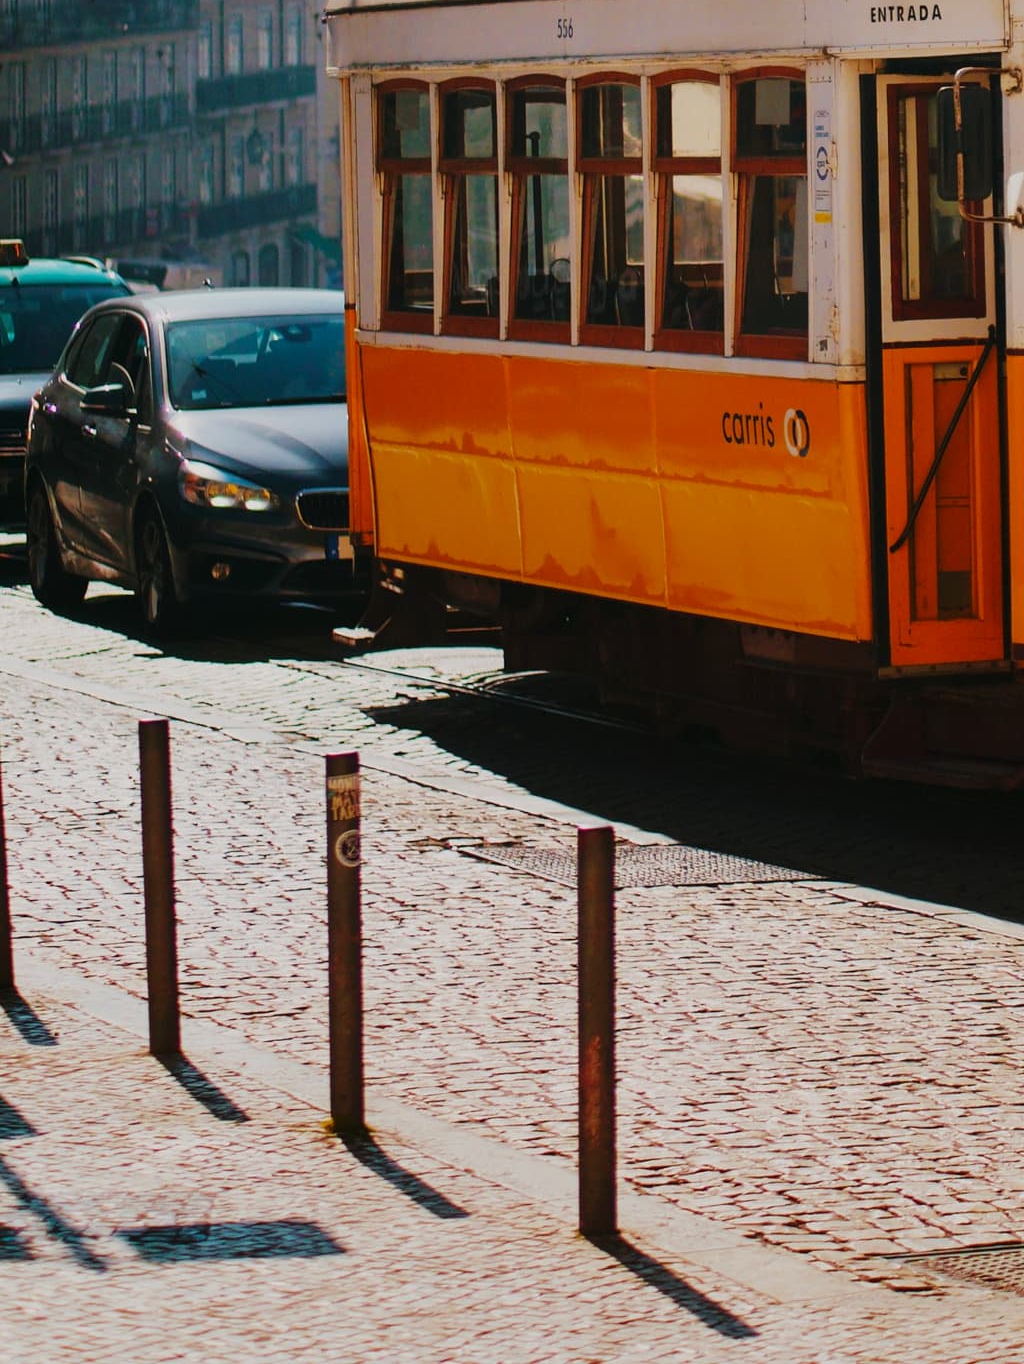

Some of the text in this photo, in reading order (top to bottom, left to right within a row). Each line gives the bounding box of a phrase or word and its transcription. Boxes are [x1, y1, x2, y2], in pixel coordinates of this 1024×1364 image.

[870, 4, 942, 23] ENTRADA
[557, 18, 574, 38] 556
[722, 401, 775, 448] carris
